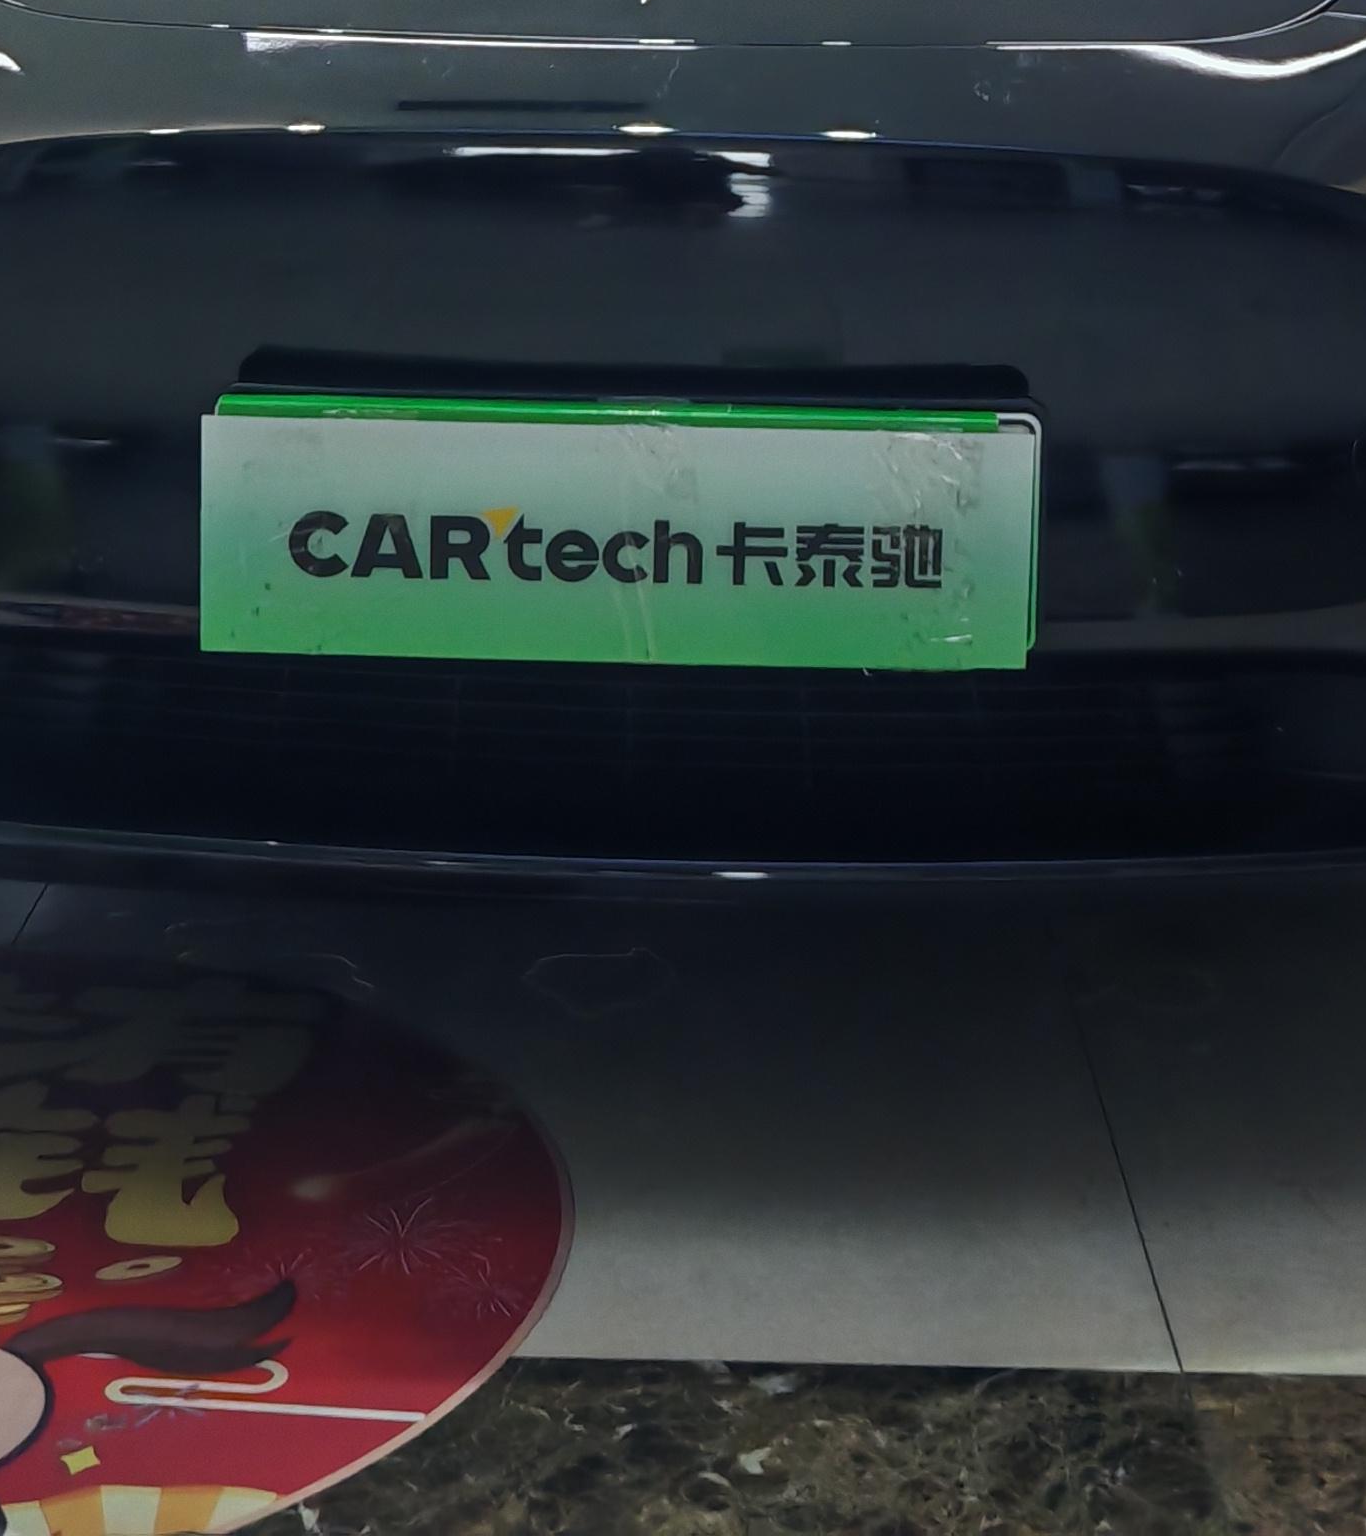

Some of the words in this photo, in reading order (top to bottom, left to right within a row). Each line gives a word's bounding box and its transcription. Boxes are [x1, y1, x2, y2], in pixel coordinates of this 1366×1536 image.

[287, 509, 703, 585] CARtech
[716, 521, 943, 589] 卡泰驰
